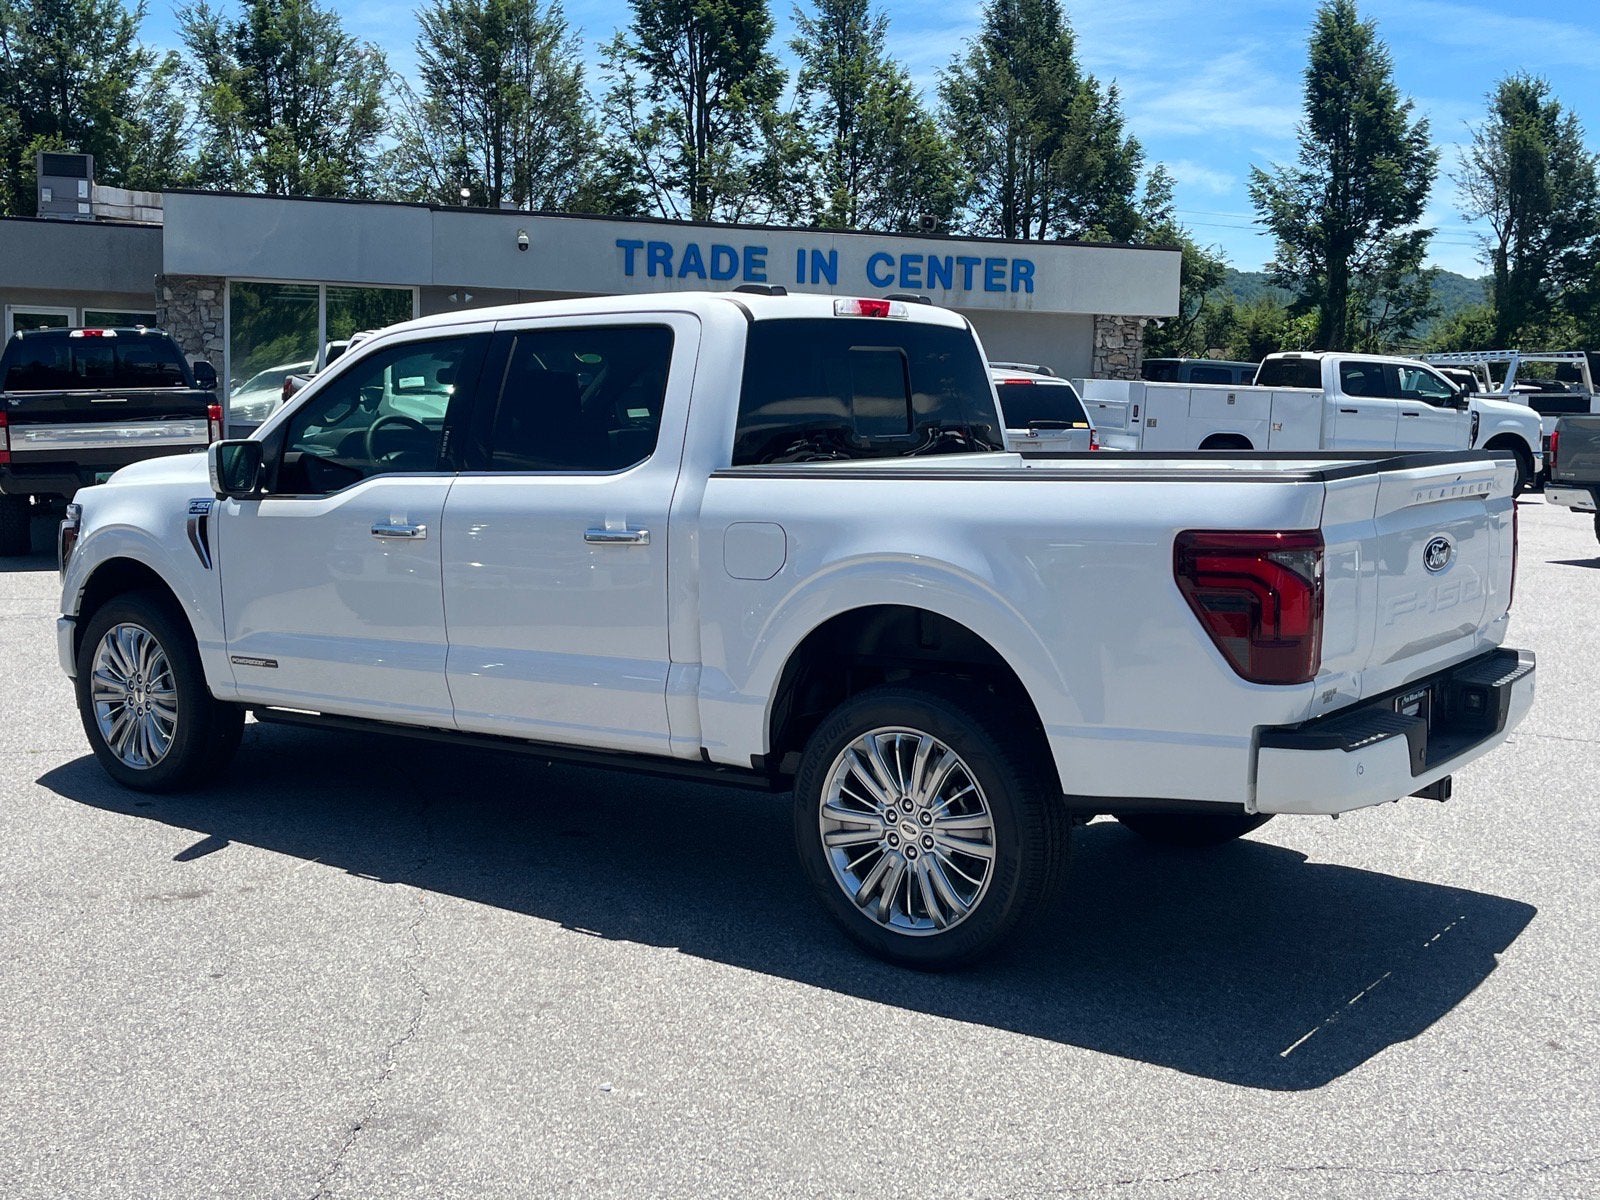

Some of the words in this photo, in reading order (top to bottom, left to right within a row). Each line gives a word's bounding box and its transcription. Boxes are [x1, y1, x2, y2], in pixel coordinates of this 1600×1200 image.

[615, 239, 768, 281] TRADE
[796, 248, 838, 285] IN
[866, 252, 1036, 293] CENTER
[1426, 540, 1452, 569] Ford
